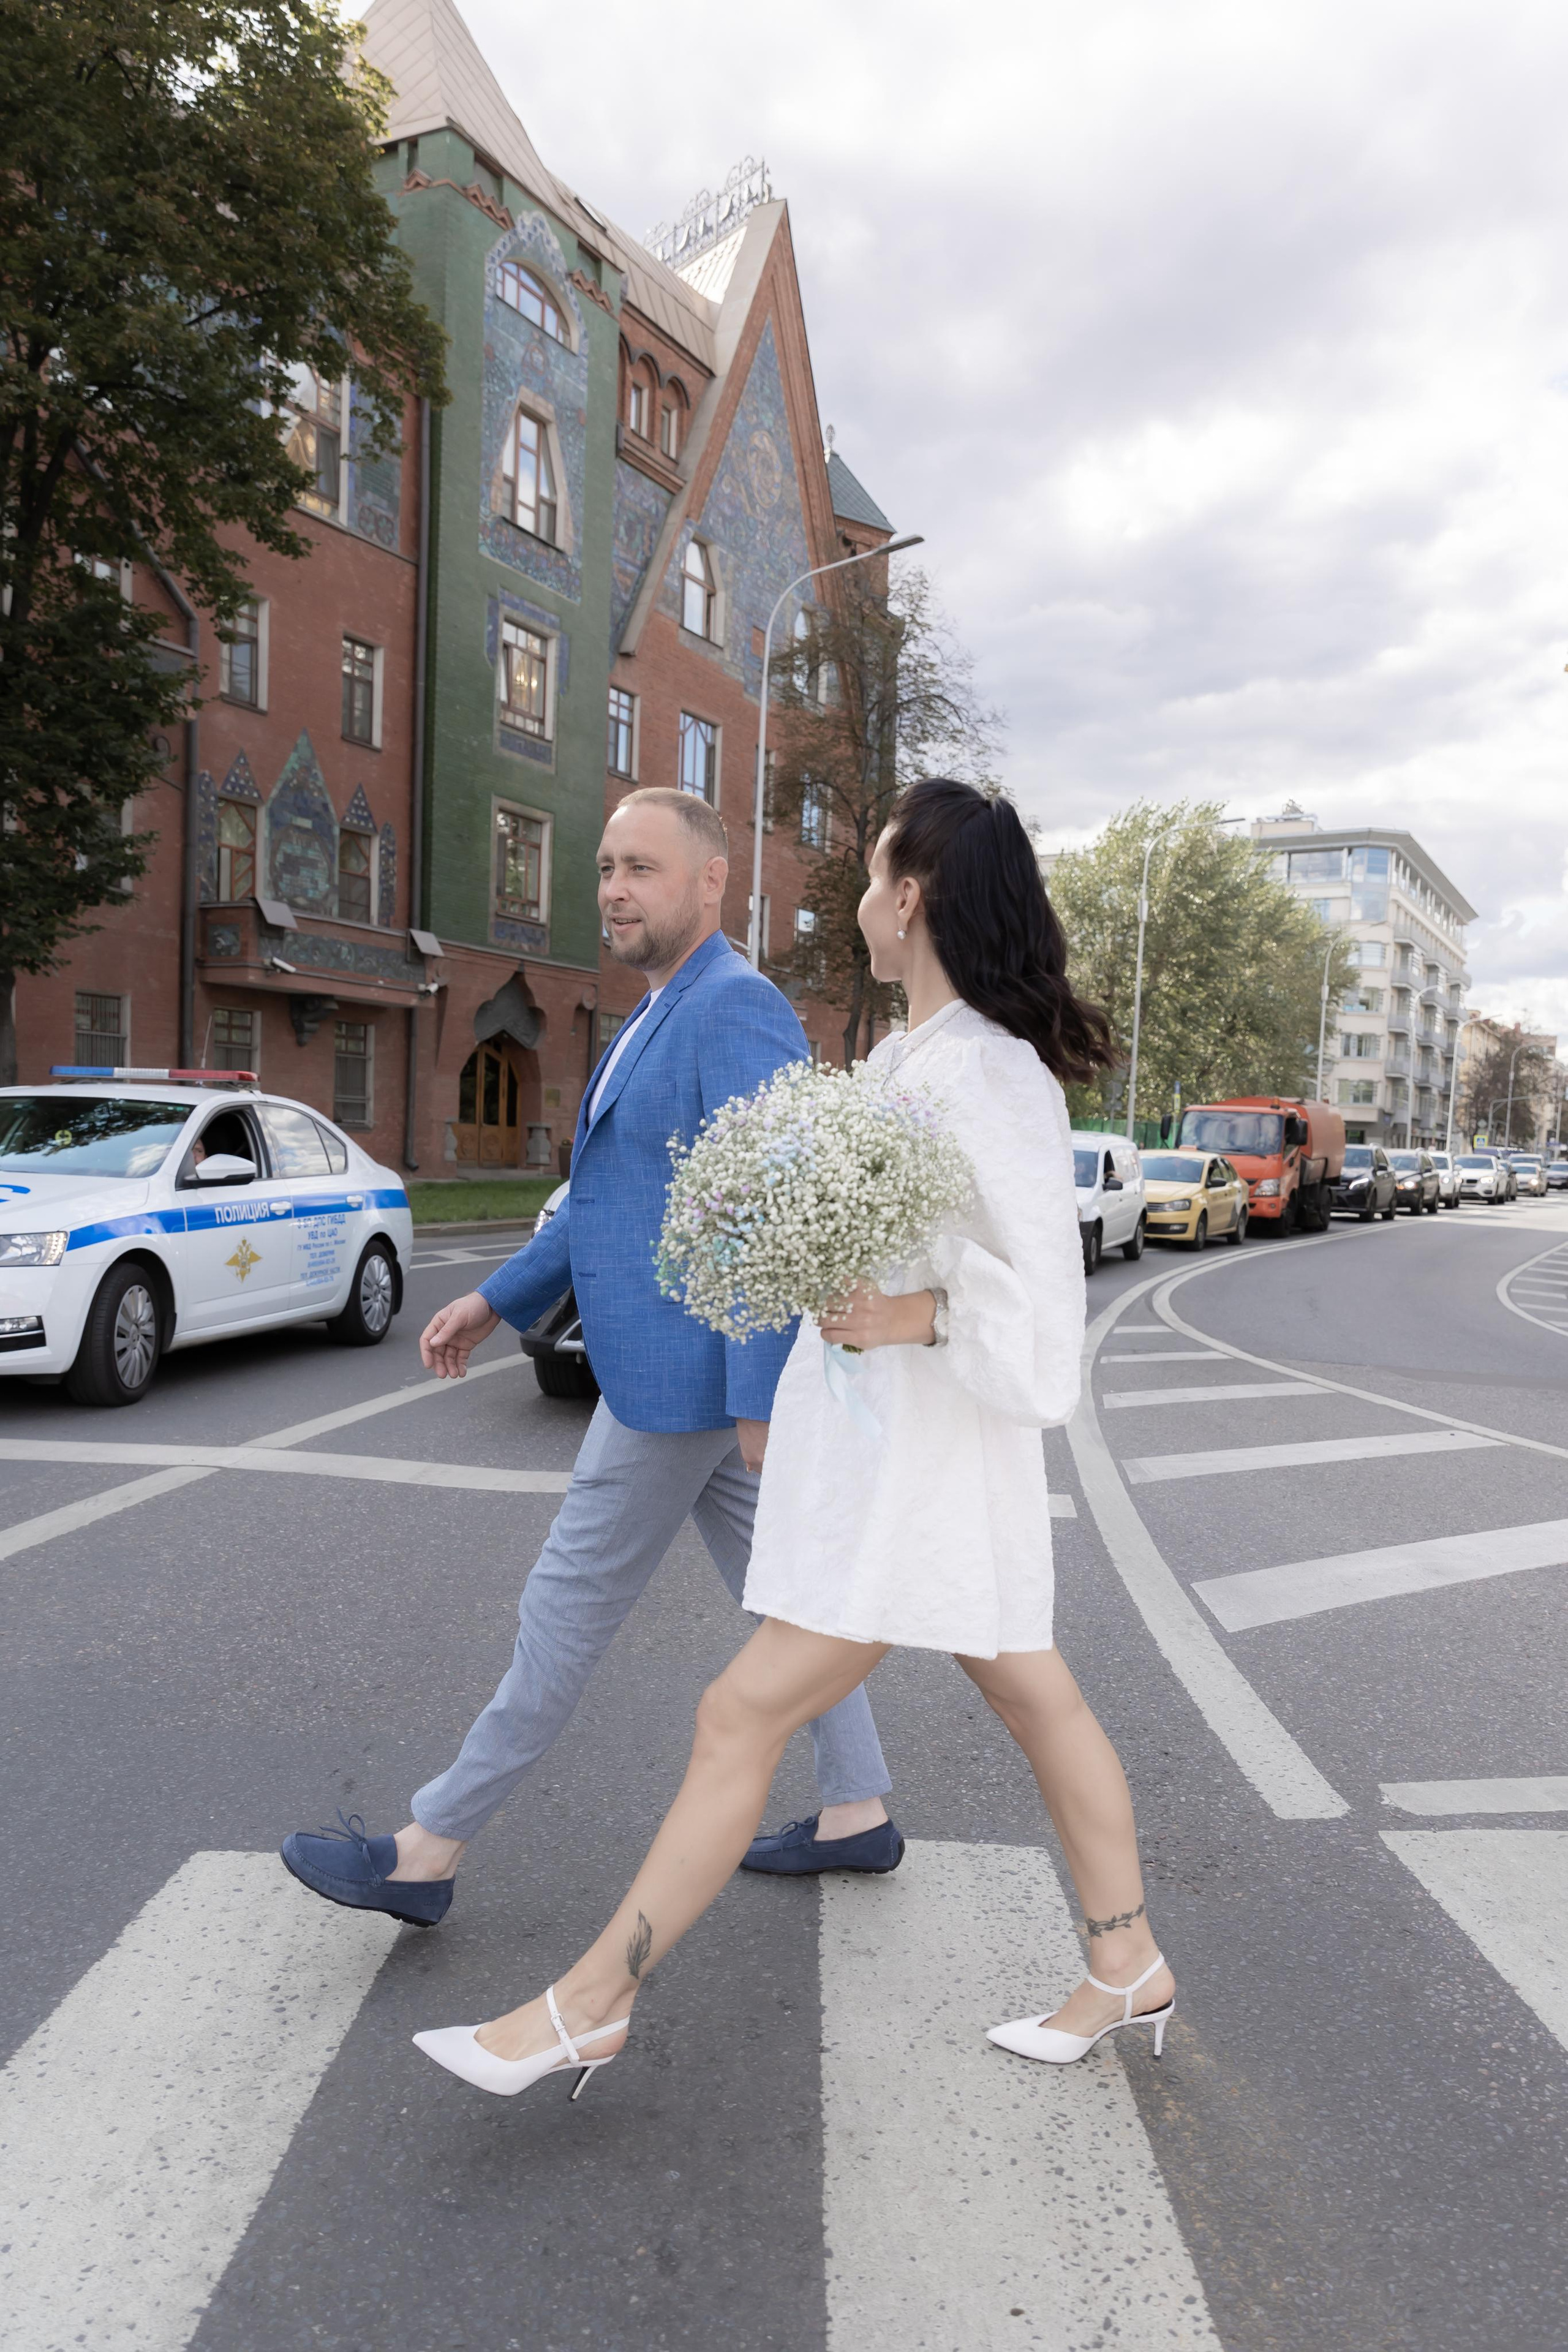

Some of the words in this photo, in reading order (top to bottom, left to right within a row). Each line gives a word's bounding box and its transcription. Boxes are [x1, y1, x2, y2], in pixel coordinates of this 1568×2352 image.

[214, 1202, 270, 1224] ПОЛИЦИЯ
[328, 1214, 346, 1225] ГИБДД
[308, 1231, 318, 1240] УВД
[327, 1227, 337, 1238] ЦАО
